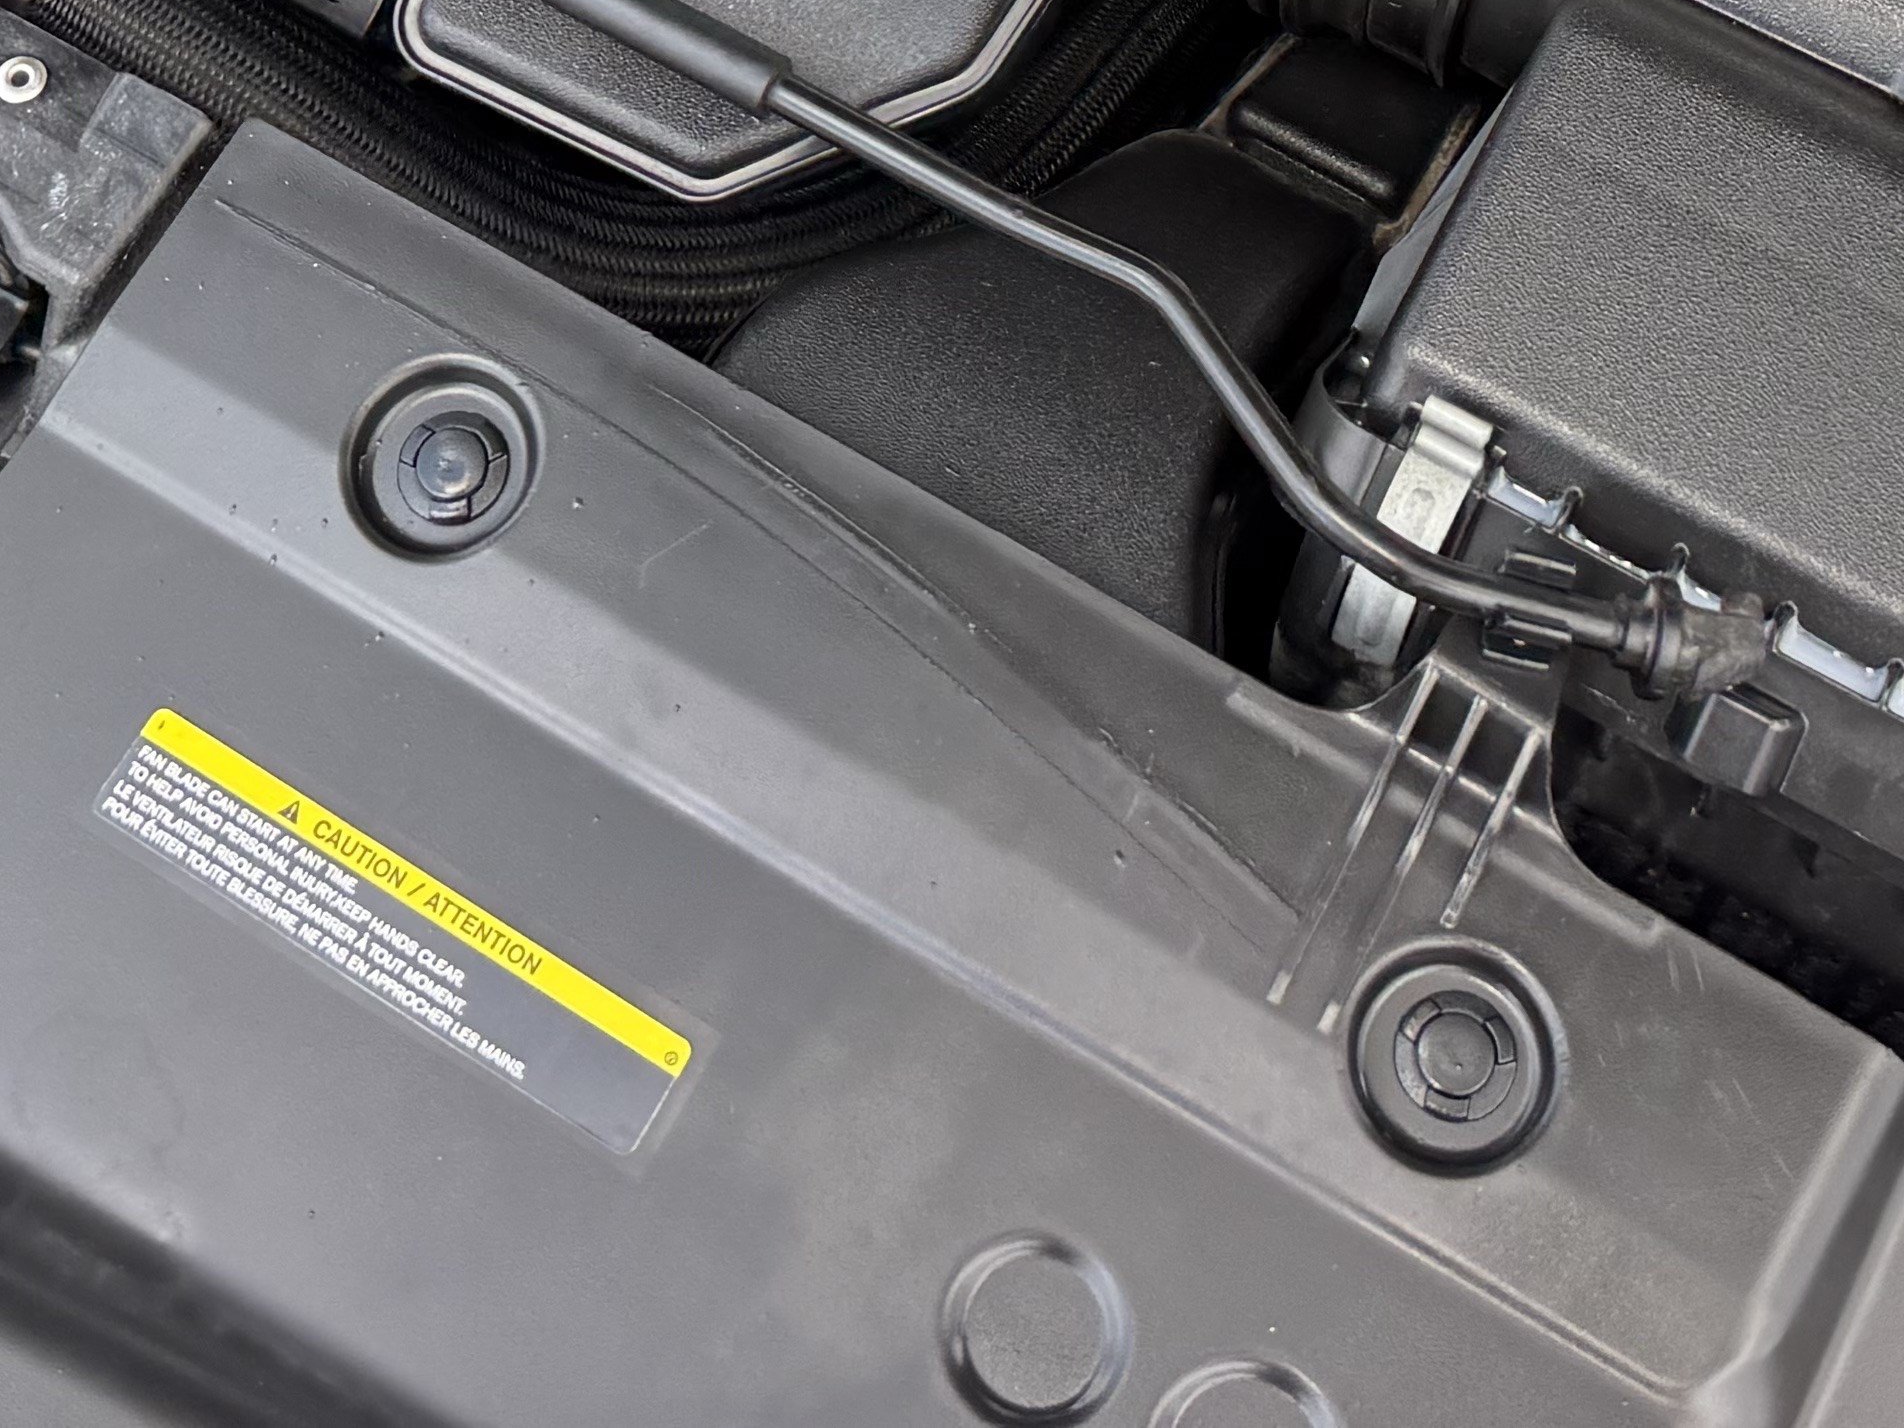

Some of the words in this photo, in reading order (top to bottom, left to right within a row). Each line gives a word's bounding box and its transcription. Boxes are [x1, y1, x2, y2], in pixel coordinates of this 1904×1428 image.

[111, 777, 136, 801] LE
[129, 789, 218, 854] VENTILATEUR
[210, 841, 267, 886] RISQUE
[260, 873, 287, 898] DE
[280, 883, 362, 945] DÉMARRER
[364, 941, 407, 976] TOUT
[400, 964, 470, 1017] MOMENT.
[124, 759, 150, 783] TO
[144, 772, 185, 806] HELP
[177, 793, 224, 831] AVOID
[218, 819, 294, 876] PERSONAL
[366, 915, 421, 958] HANDS
[414, 945, 469, 989] CLEAR.
[136, 743, 169, 772] FAN
[162, 760, 211, 799] BLADE
[204, 787, 240, 818] CAN
[234, 806, 282, 844] START
[275, 832, 299, 855] AT
[292, 843, 327, 873] ANY
[321, 862, 361, 896] TIME.
[309, 816, 409, 890] CAUTION
[406, 877, 426, 901] /
[421, 888, 544, 976] ATTENTION
[100, 794, 145, 831] POUR
[137, 815, 191, 860] ÉVITER
[182, 847, 231, 887] TOUTE
[223, 875, 303, 935] BLESSURE,
[296, 921, 323, 947] NE
[315, 934, 351, 966] PAS
[344, 953, 371, 978] EN
[363, 966, 455, 1033] APPROCHER
[448, 1020, 482, 1050] LES
[475, 1038, 530, 1081] MAINS.
